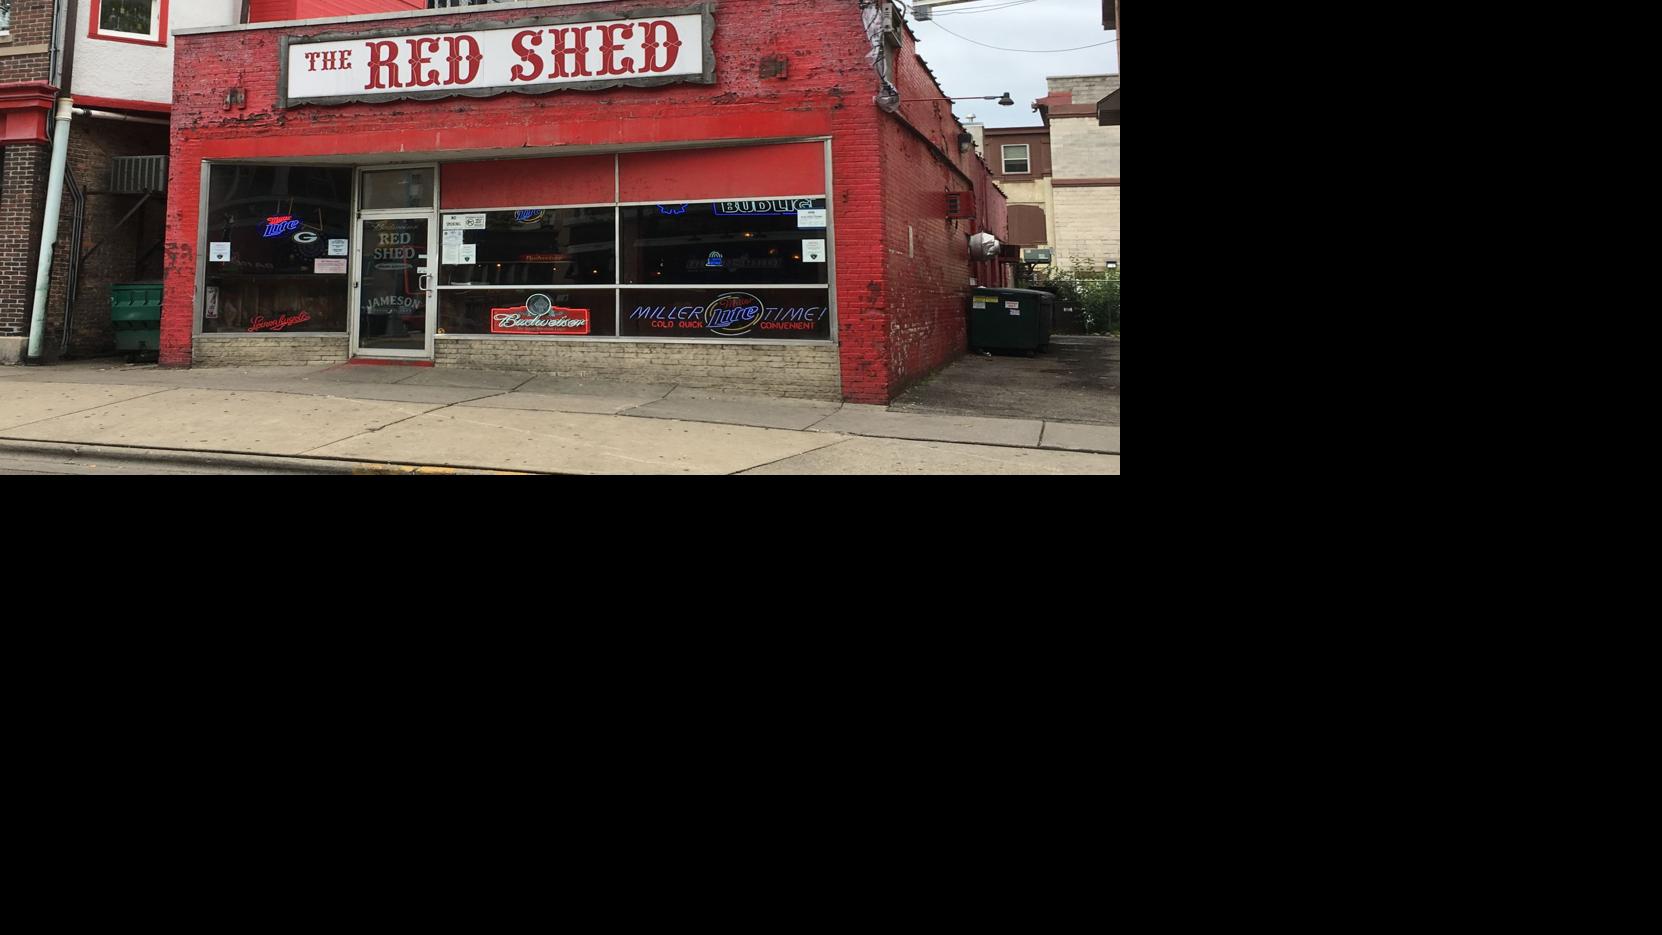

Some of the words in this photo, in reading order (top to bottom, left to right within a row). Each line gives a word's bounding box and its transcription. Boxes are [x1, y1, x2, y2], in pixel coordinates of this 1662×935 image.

[305, 50, 353, 72] THE
[364, 35, 483, 90] RED
[510, 20, 682, 82] SHED
[379, 232, 412, 245] RED
[373, 247, 416, 260] SHED
[367, 295, 422, 309] JAMESON
[493, 311, 586, 328] Budweiser
[629, 306, 705, 320] MILLER
[705, 305, 759, 328] Lite
[651, 320, 675, 329] COLD
[678, 320, 703, 329] QUICK
[760, 321, 818, 331] CONVENIENT
